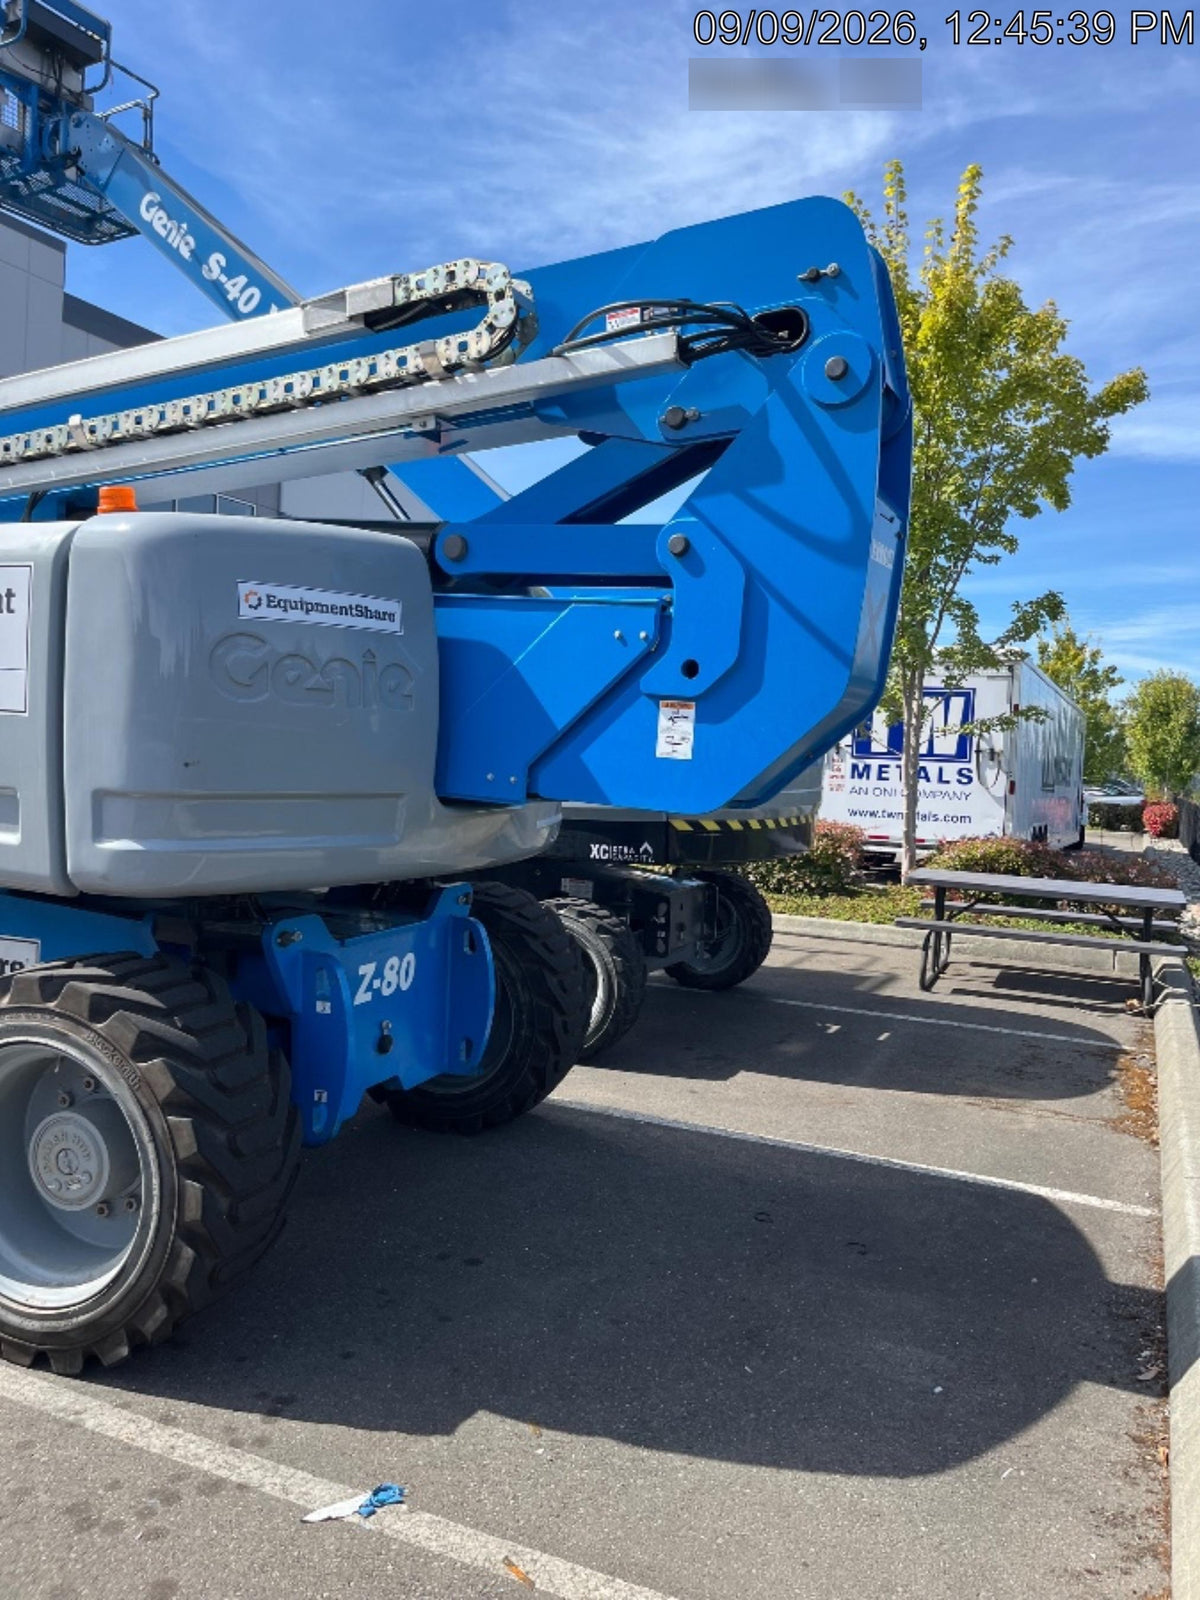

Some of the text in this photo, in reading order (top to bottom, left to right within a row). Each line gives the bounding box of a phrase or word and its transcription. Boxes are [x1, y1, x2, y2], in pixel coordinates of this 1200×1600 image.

[139, 191, 262, 314] Genie S-40
[265, 593, 397, 623] EquipmentShare
[208, 631, 415, 712] Genie
[849, 785, 869, 796] AN
[872, 786, 897, 798] ONI
[847, 807, 973, 824] www.twmtals.com
[589, 843, 610, 860] XC
[353, 952, 417, 1007] Z-80
